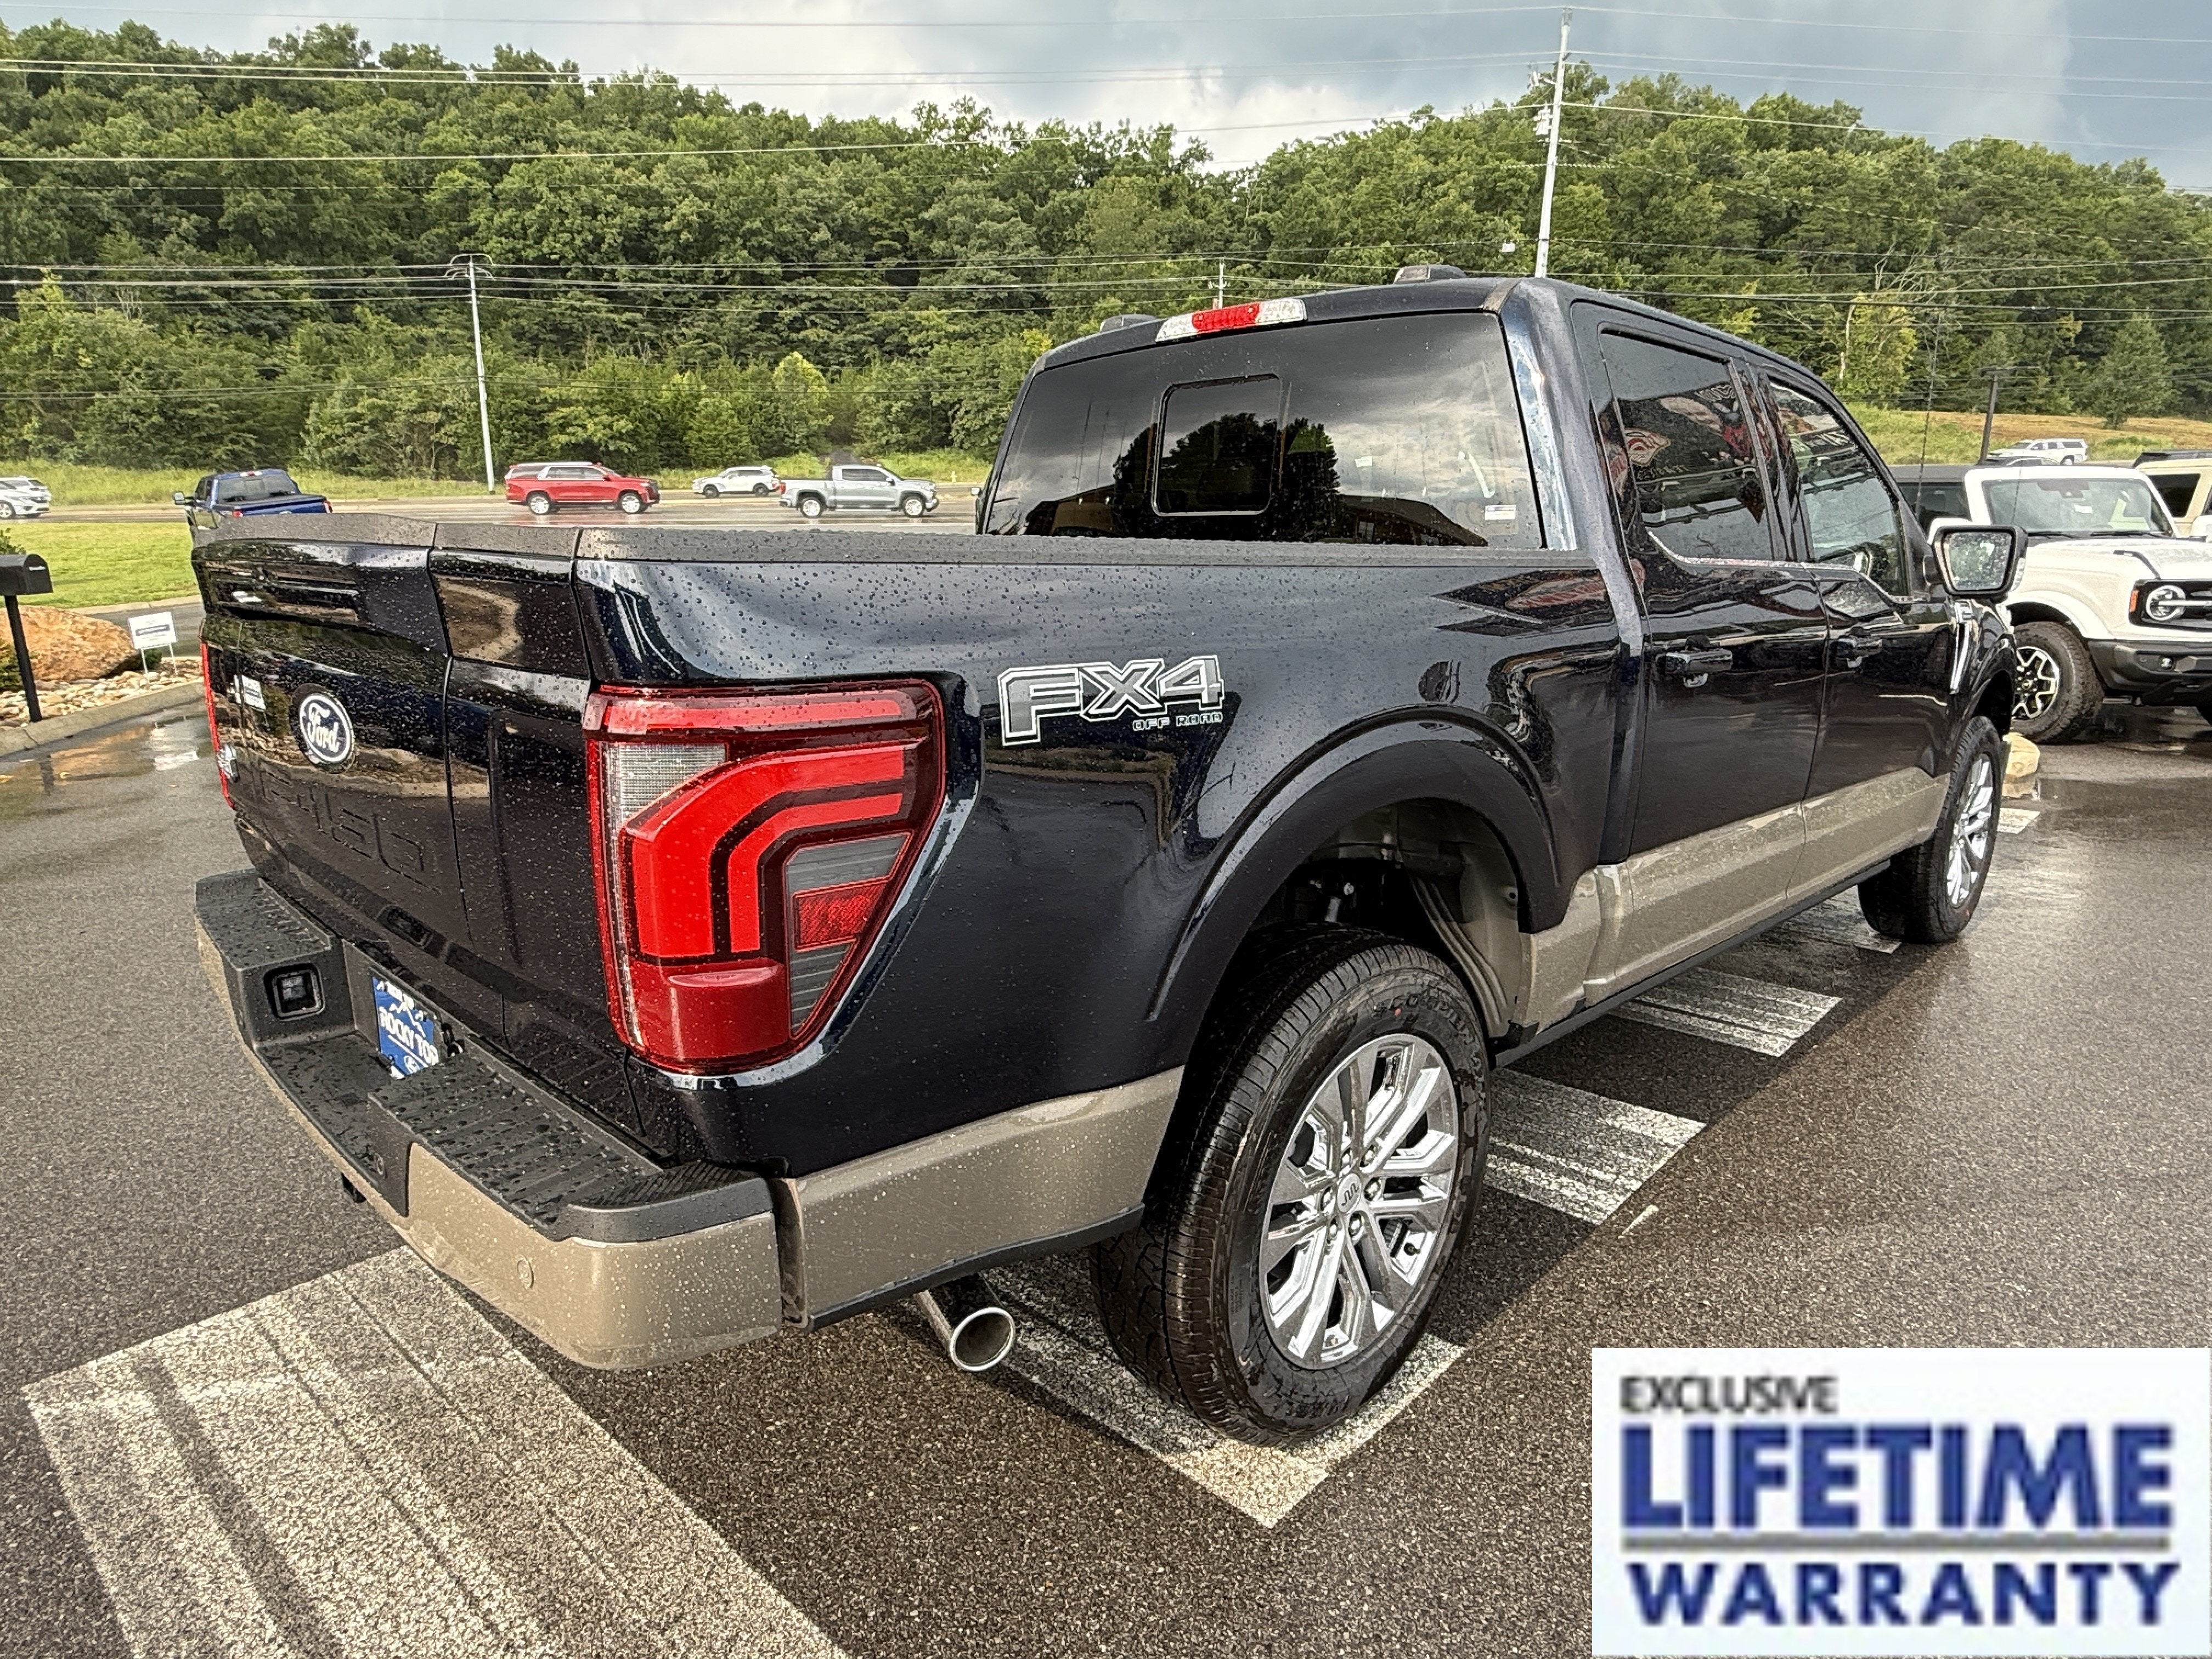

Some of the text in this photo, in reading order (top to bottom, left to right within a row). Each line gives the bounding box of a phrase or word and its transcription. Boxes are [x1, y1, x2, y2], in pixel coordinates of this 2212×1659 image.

[997, 654, 1224, 746] FX4
[1132, 712, 1223, 732] OFF ROAD
[307, 702, 341, 753] Ford
